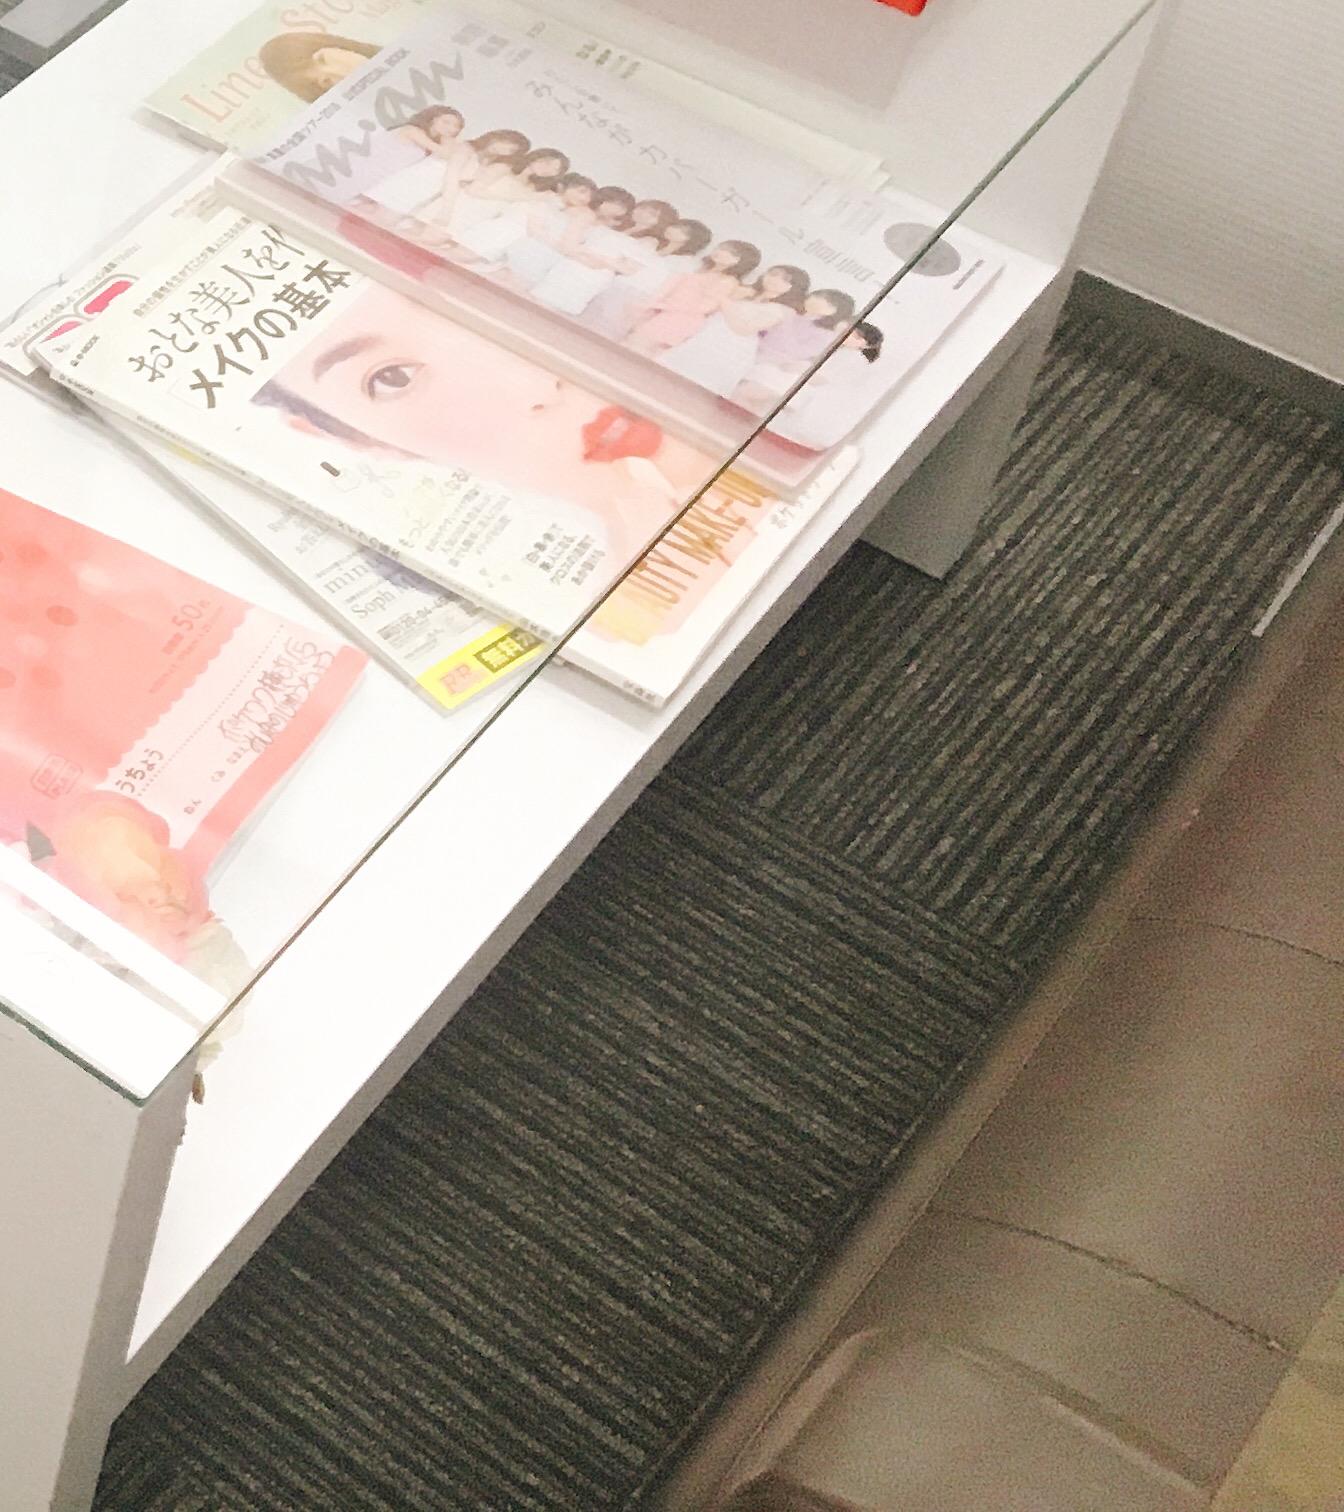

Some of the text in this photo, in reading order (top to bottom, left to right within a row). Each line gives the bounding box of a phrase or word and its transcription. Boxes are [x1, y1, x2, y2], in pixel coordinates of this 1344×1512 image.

[188, 259, 352, 410] メイクの基本
